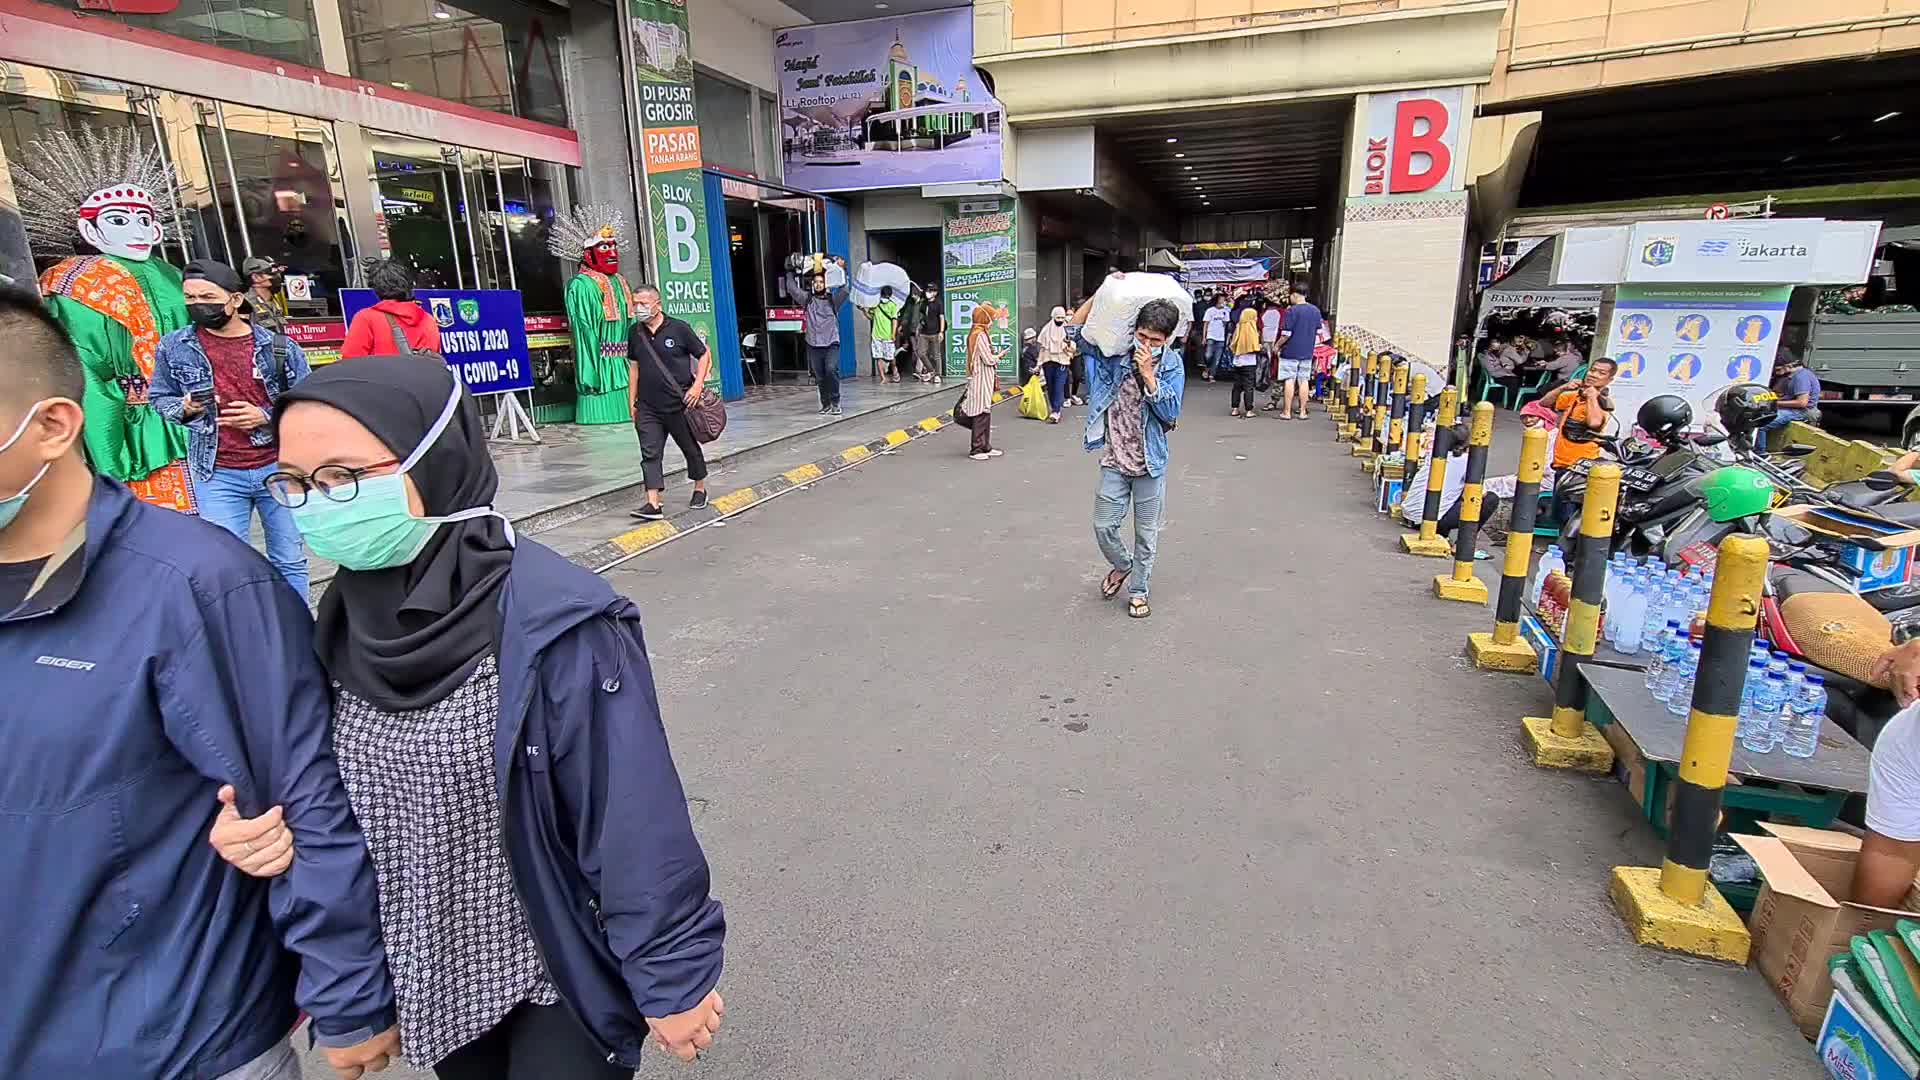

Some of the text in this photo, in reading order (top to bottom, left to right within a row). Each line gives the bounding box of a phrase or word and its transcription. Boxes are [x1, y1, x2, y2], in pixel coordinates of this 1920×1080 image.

[643, 85, 692, 101] DI PUSAT
[800, 96, 836, 107] Rooftop
[645, 103, 694, 121] GROSIR
[648, 132, 697, 154] PASAR
[1364, 98, 1451, 195] BLOK B
[650, 154, 675, 165] TANAH
[662, 184, 693, 203] BLOK
[664, 203, 700, 274] B
[955, 273, 984, 282] PUSAT
[665, 281, 709, 300] SPACE
[951, 292, 979, 300] BLOK
[1490, 294, 1521, 303] BANK
[668, 302, 711, 314] AVAILABLE
[440, 328, 509, 354] USTISI 2020
[463, 358, 519, 384] COVID-19
[35, 655, 97, 671] EIGER
